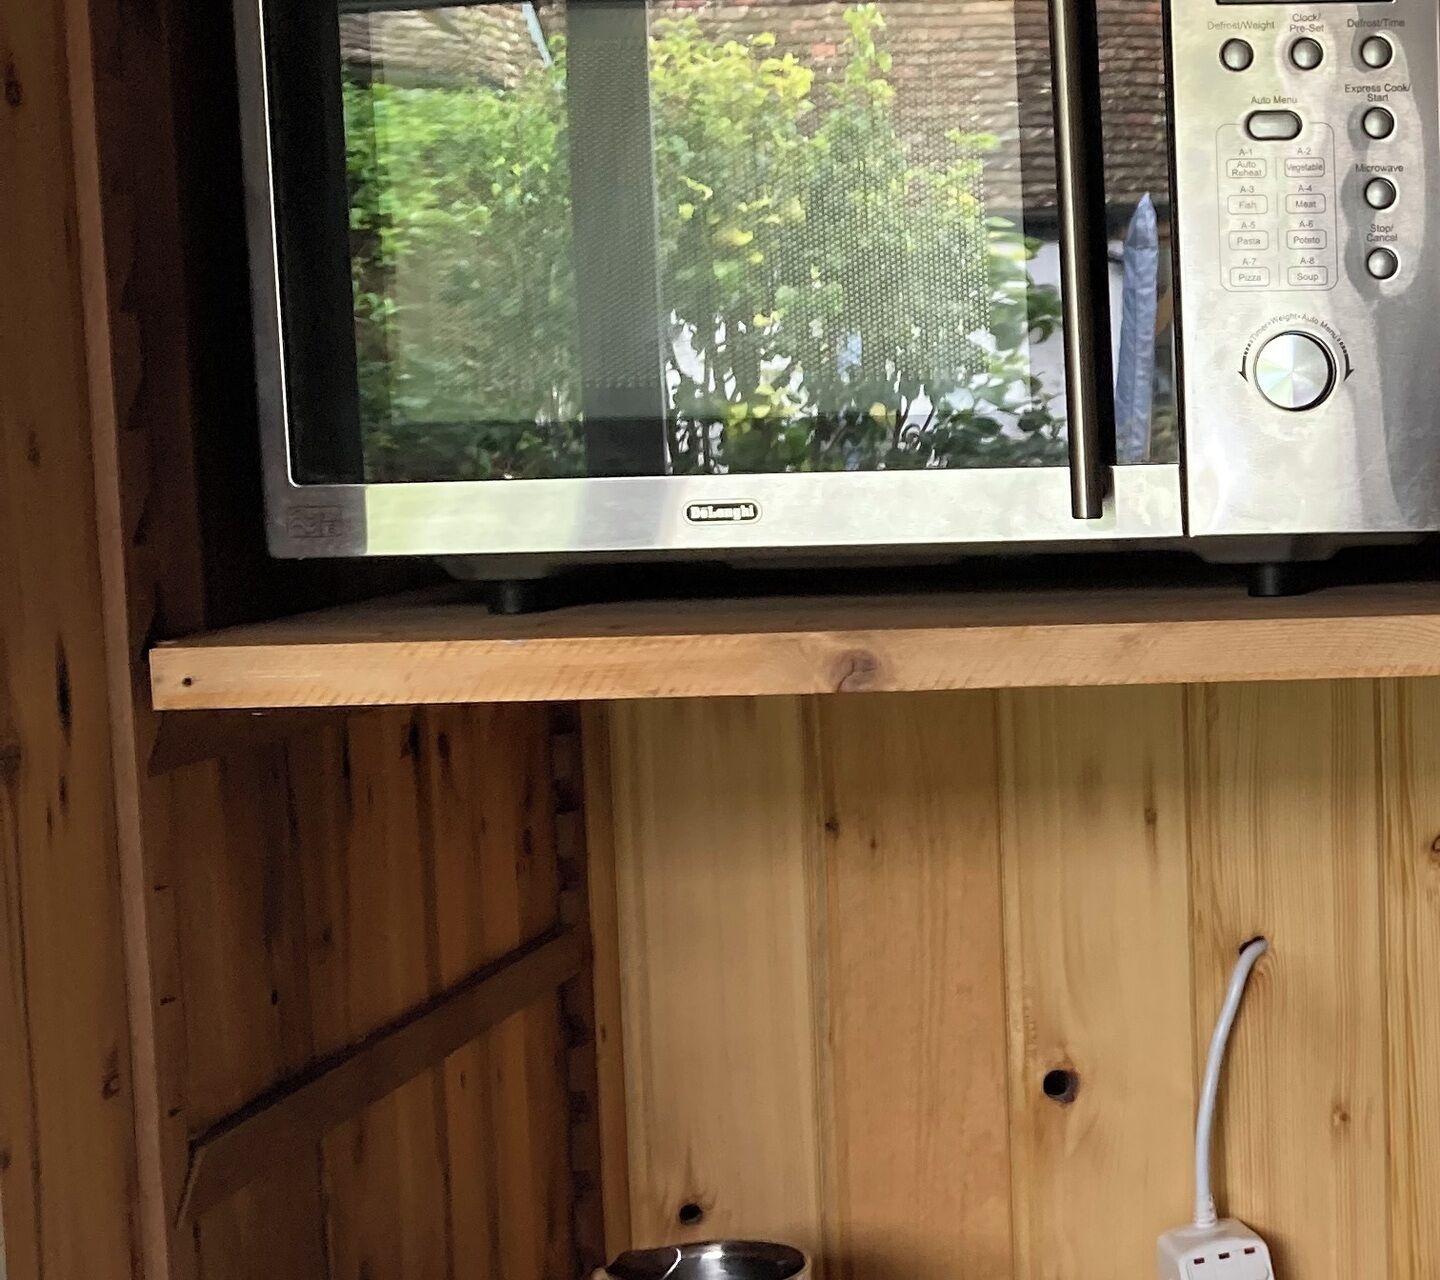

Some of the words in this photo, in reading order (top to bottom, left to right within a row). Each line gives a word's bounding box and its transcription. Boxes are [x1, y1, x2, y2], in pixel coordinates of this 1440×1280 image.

[1345, 84, 1381, 93] Express
[1251, 95, 1271, 104] Auto
[1273, 95, 1298, 104] Menu
[1367, 92, 1389, 102] Start
[1236, 160, 1257, 168] Auto
[1355, 163, 1404, 173] Microwave
[1366, 232, 1398, 242] Cancel
